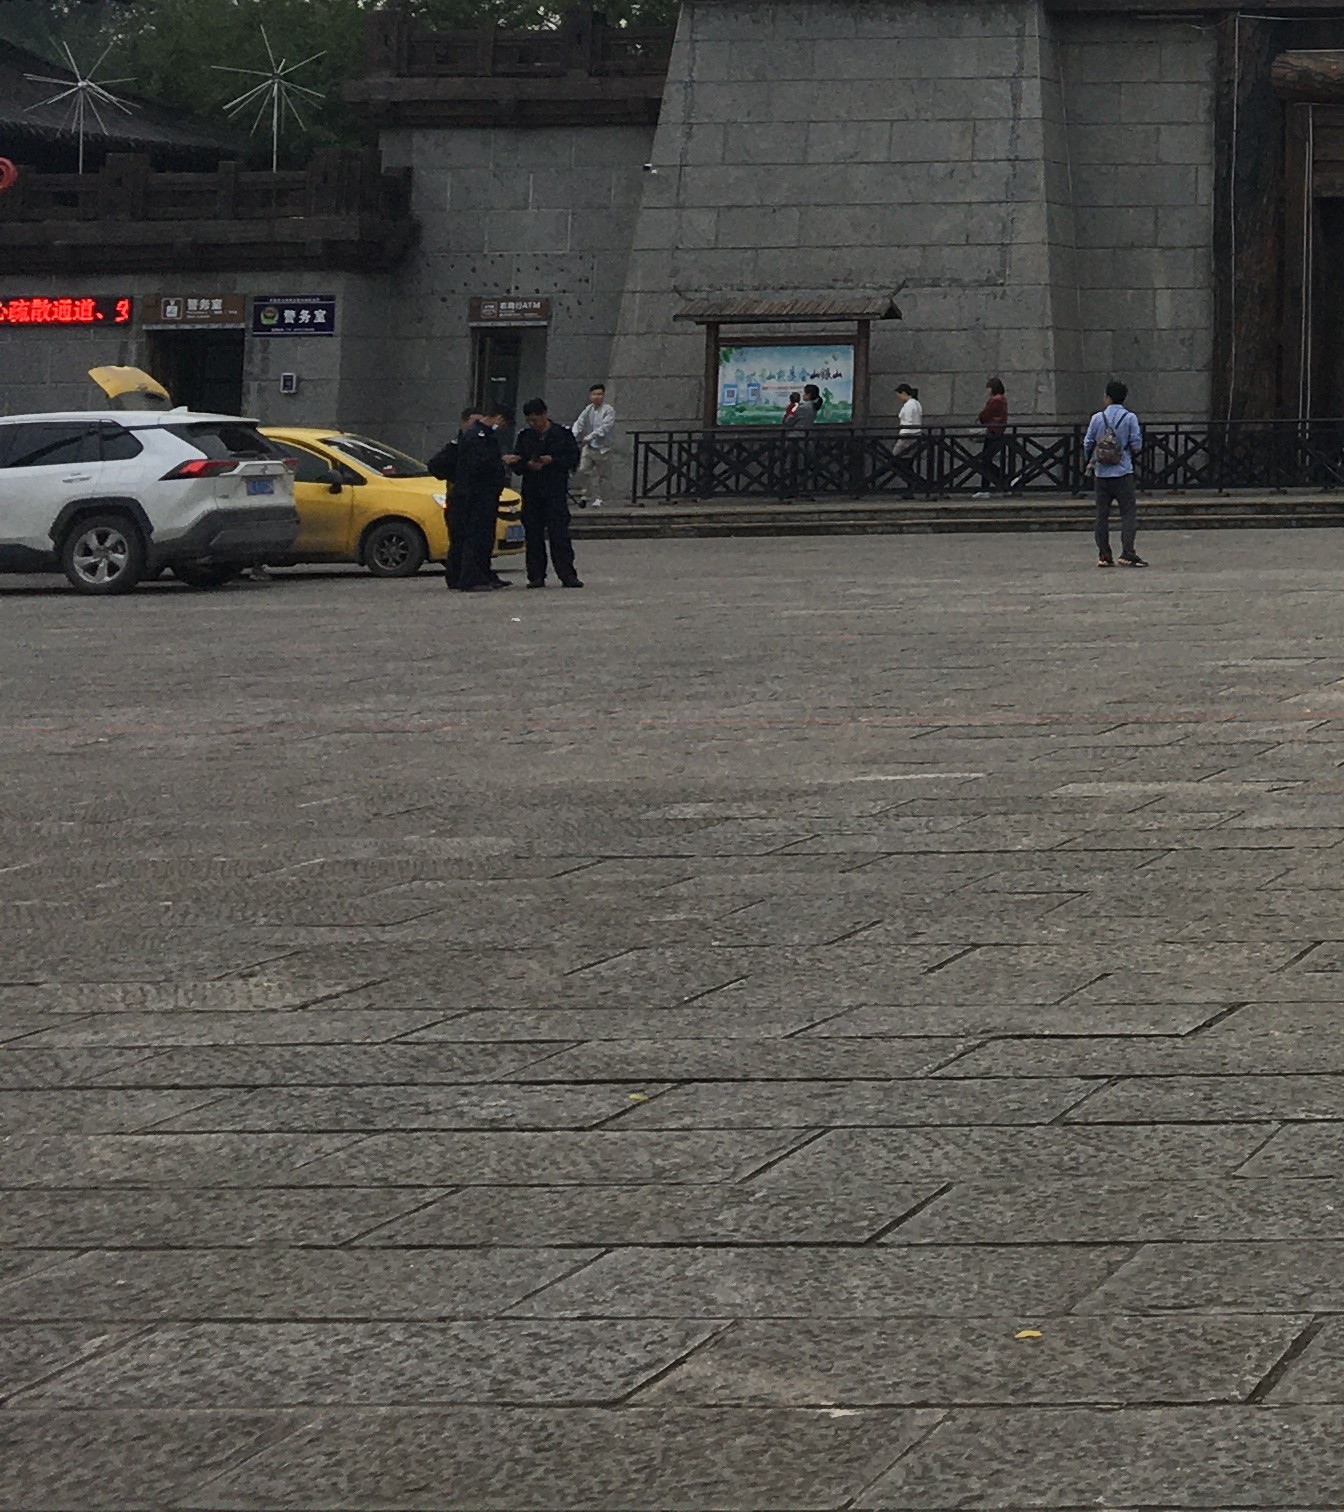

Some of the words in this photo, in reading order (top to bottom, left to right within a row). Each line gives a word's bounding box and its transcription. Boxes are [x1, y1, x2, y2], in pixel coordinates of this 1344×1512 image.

[187, 298, 223, 310] 警务室
[283, 309, 326, 324] 警务室
